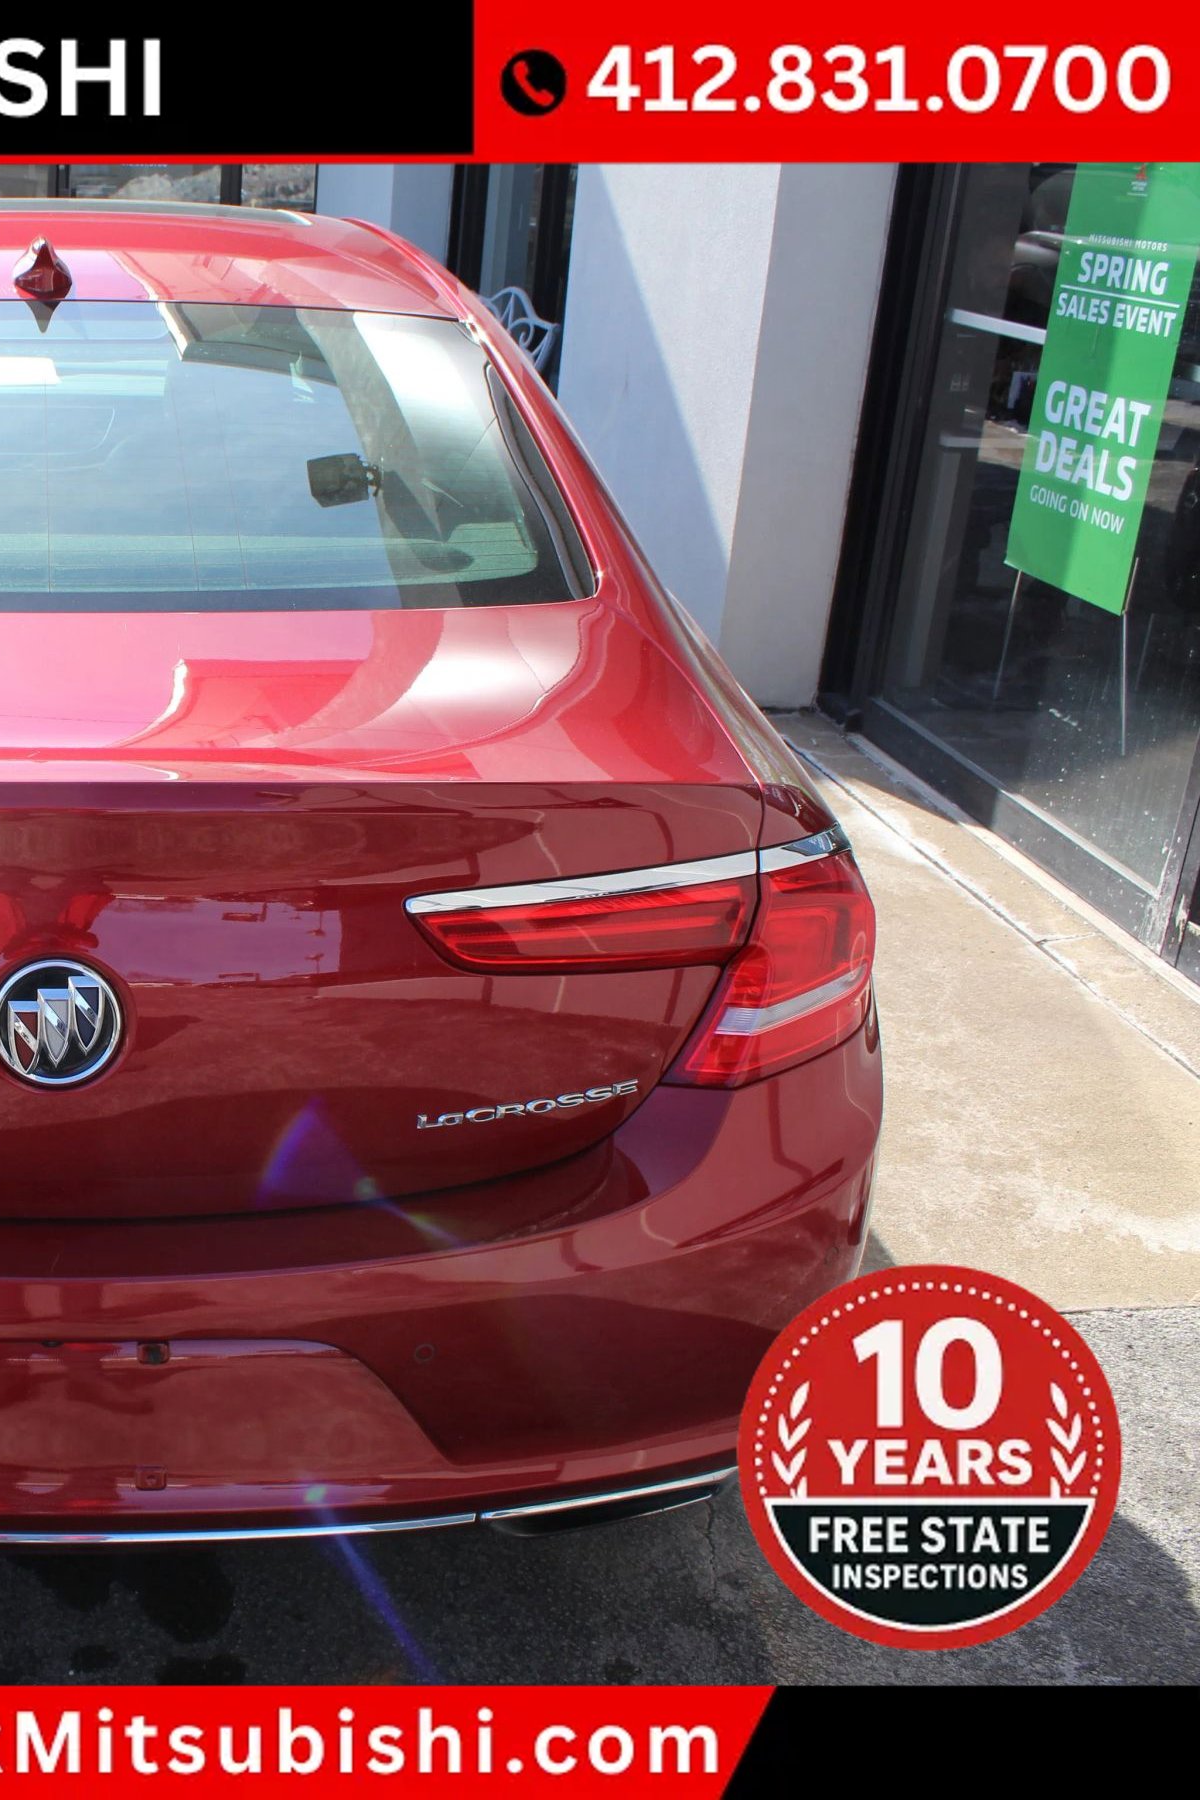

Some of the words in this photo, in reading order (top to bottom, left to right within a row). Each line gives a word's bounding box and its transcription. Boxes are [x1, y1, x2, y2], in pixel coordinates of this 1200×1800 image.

[1088, 234, 1132, 248] MITSUBISHI
[1134, 240, 1168, 252] MOTORS
[1077, 251, 1169, 295] SPRING
[1056, 292, 1111, 325] SALES
[1112, 303, 1177, 337] EVENT
[1045, 380, 1152, 447] GREAT
[1035, 430, 1137, 501] DEALS
[1030, 485, 1068, 513] GOING
[1069, 500, 1090, 522] ON
[1091, 507, 1125, 535] NOW
